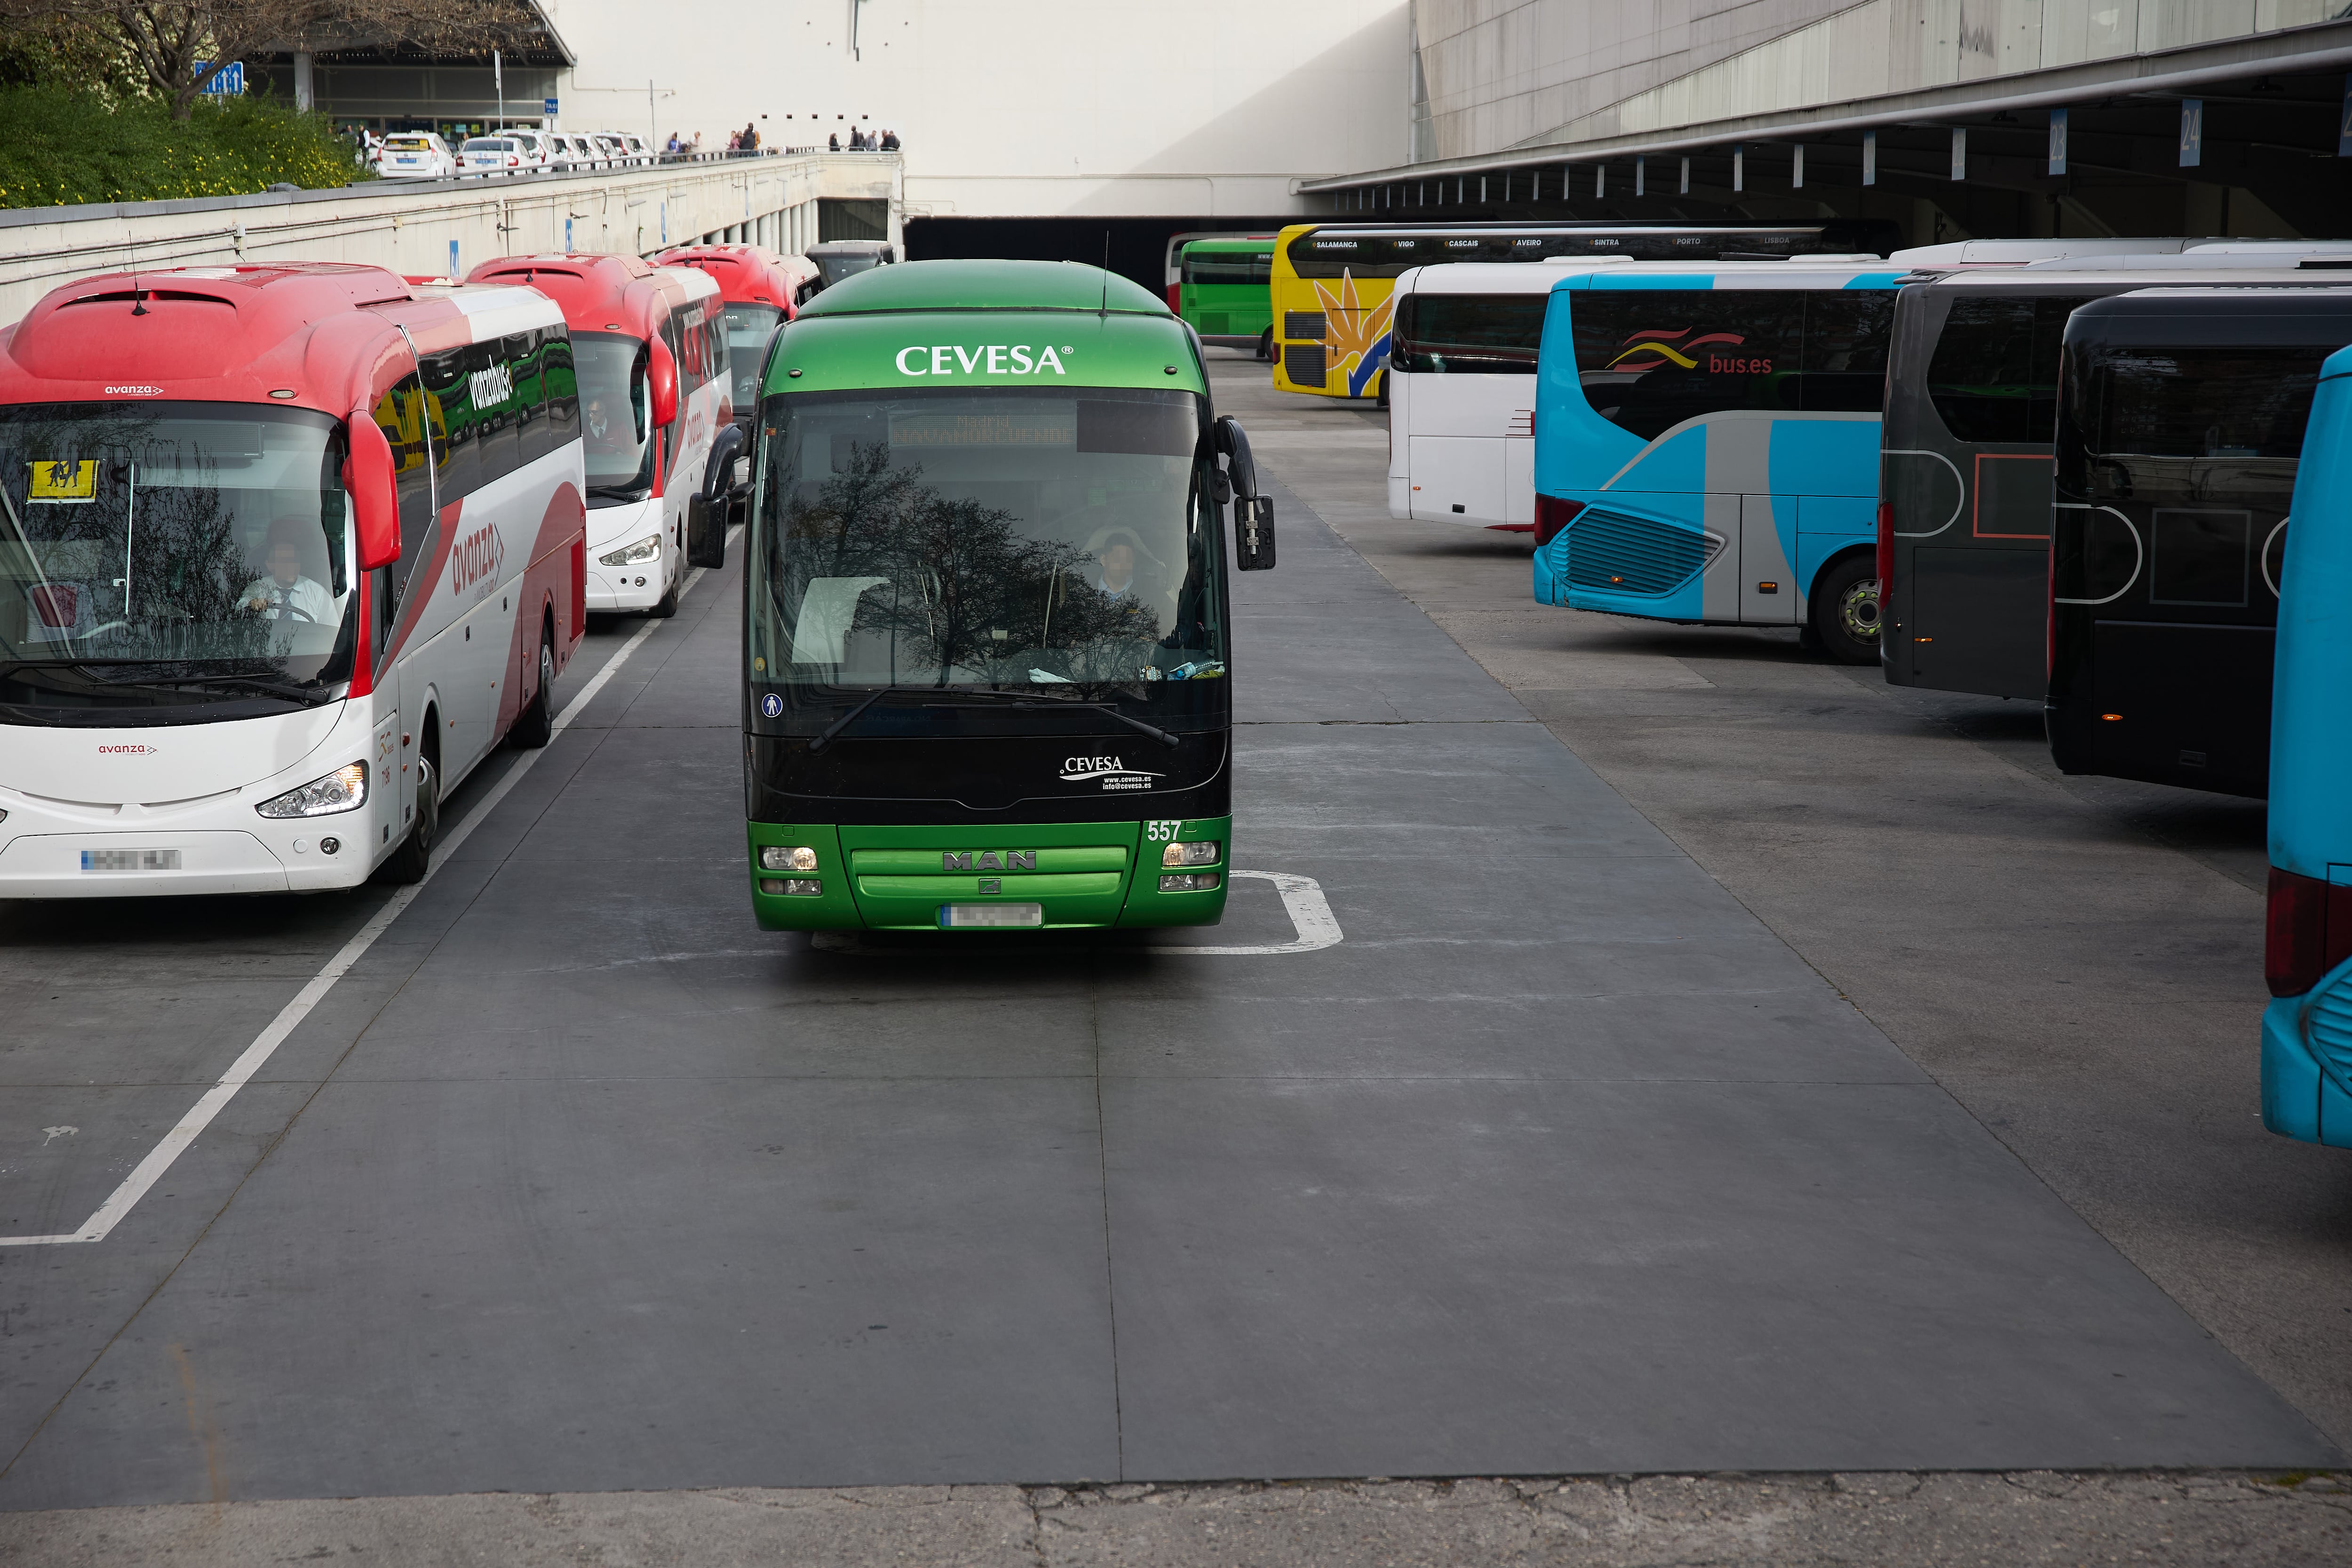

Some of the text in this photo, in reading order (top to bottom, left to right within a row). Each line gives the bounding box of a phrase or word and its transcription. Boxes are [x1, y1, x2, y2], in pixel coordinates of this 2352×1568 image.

[2182, 109, 2199, 150] 24
[2051, 124, 2065, 160] 23
[1709, 353, 1772, 373] bus.es
[105, 386, 151, 395] avanza
[688, 410, 701, 450] avanza
[957, 414, 1009, 429] Madrid
[453, 522, 494, 597] avanza
[1065, 756, 1123, 772] CEVESA
[1147, 821, 1182, 841] 557
[943, 851, 1036, 871] MAN
